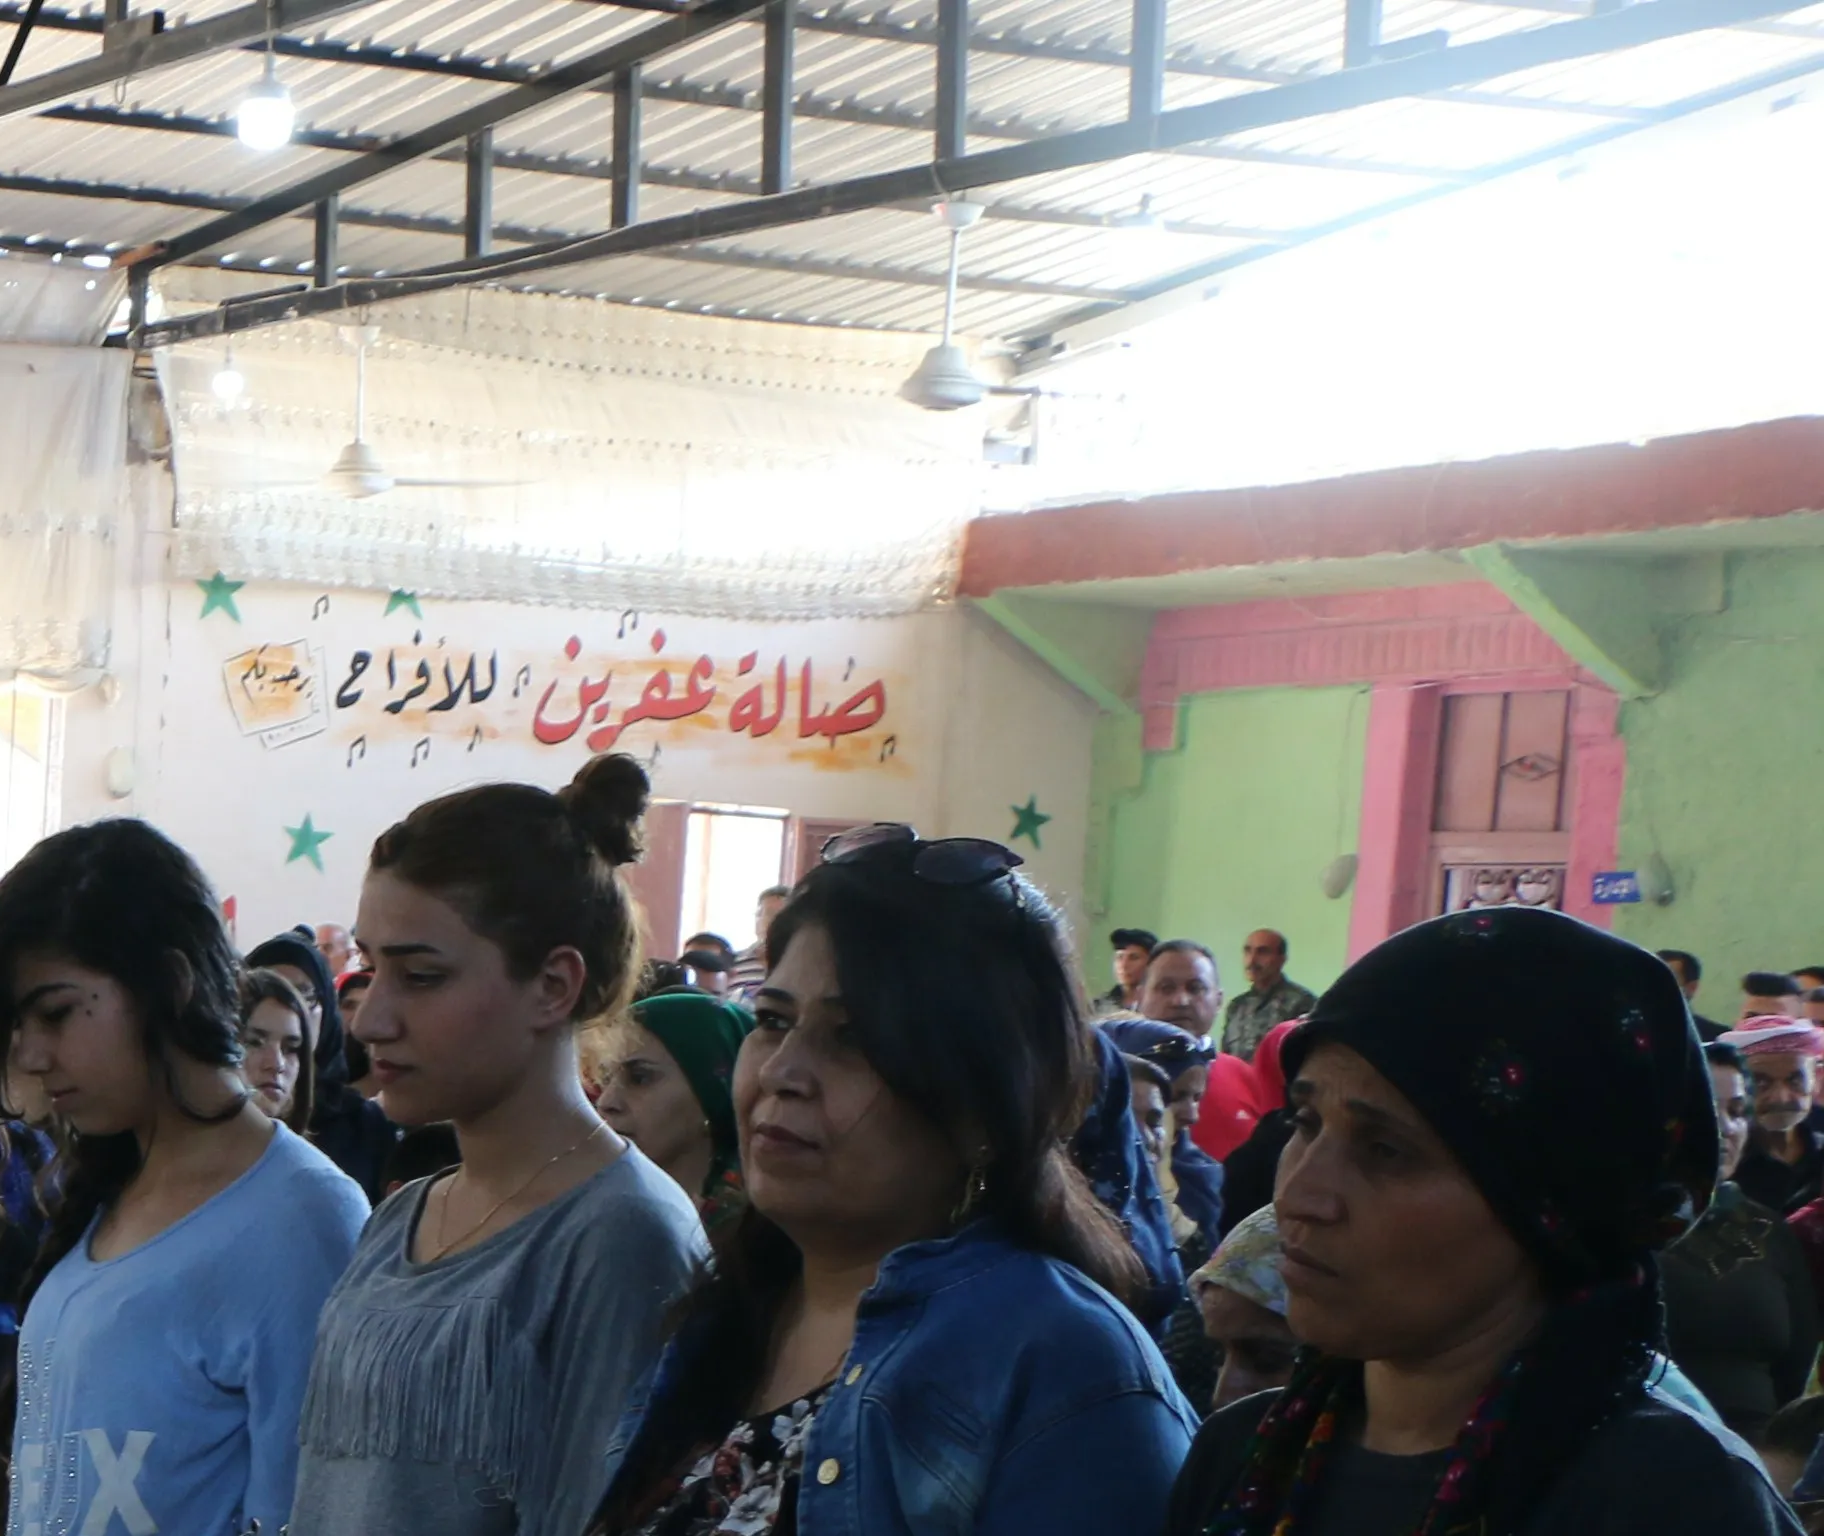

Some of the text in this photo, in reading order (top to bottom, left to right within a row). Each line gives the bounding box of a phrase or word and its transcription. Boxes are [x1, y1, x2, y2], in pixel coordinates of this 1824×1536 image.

[335, 629, 887, 751] صالة عفرين للأفراح
